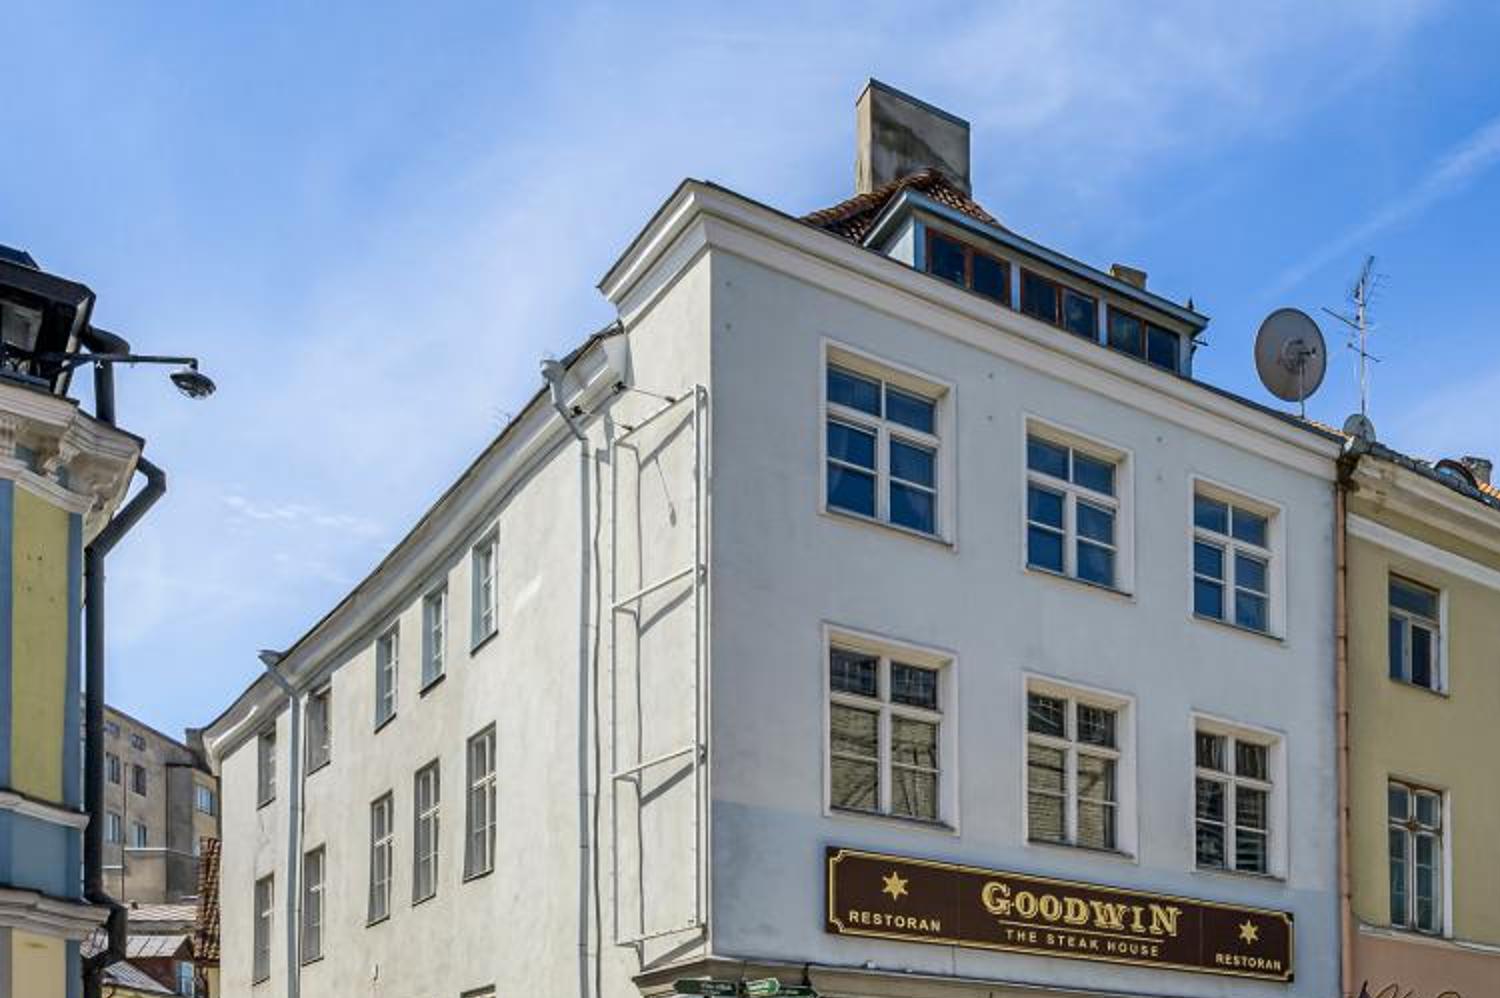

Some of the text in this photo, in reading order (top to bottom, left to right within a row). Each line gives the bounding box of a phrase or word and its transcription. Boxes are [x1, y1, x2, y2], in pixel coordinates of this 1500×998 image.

[849, 909, 941, 932] RESTORAN
[981, 881, 1183, 937] GOODWIN
[1006, 929, 1159, 957] THE STEAK HOUSE
[1215, 953, 1281, 971] RESTORAN
